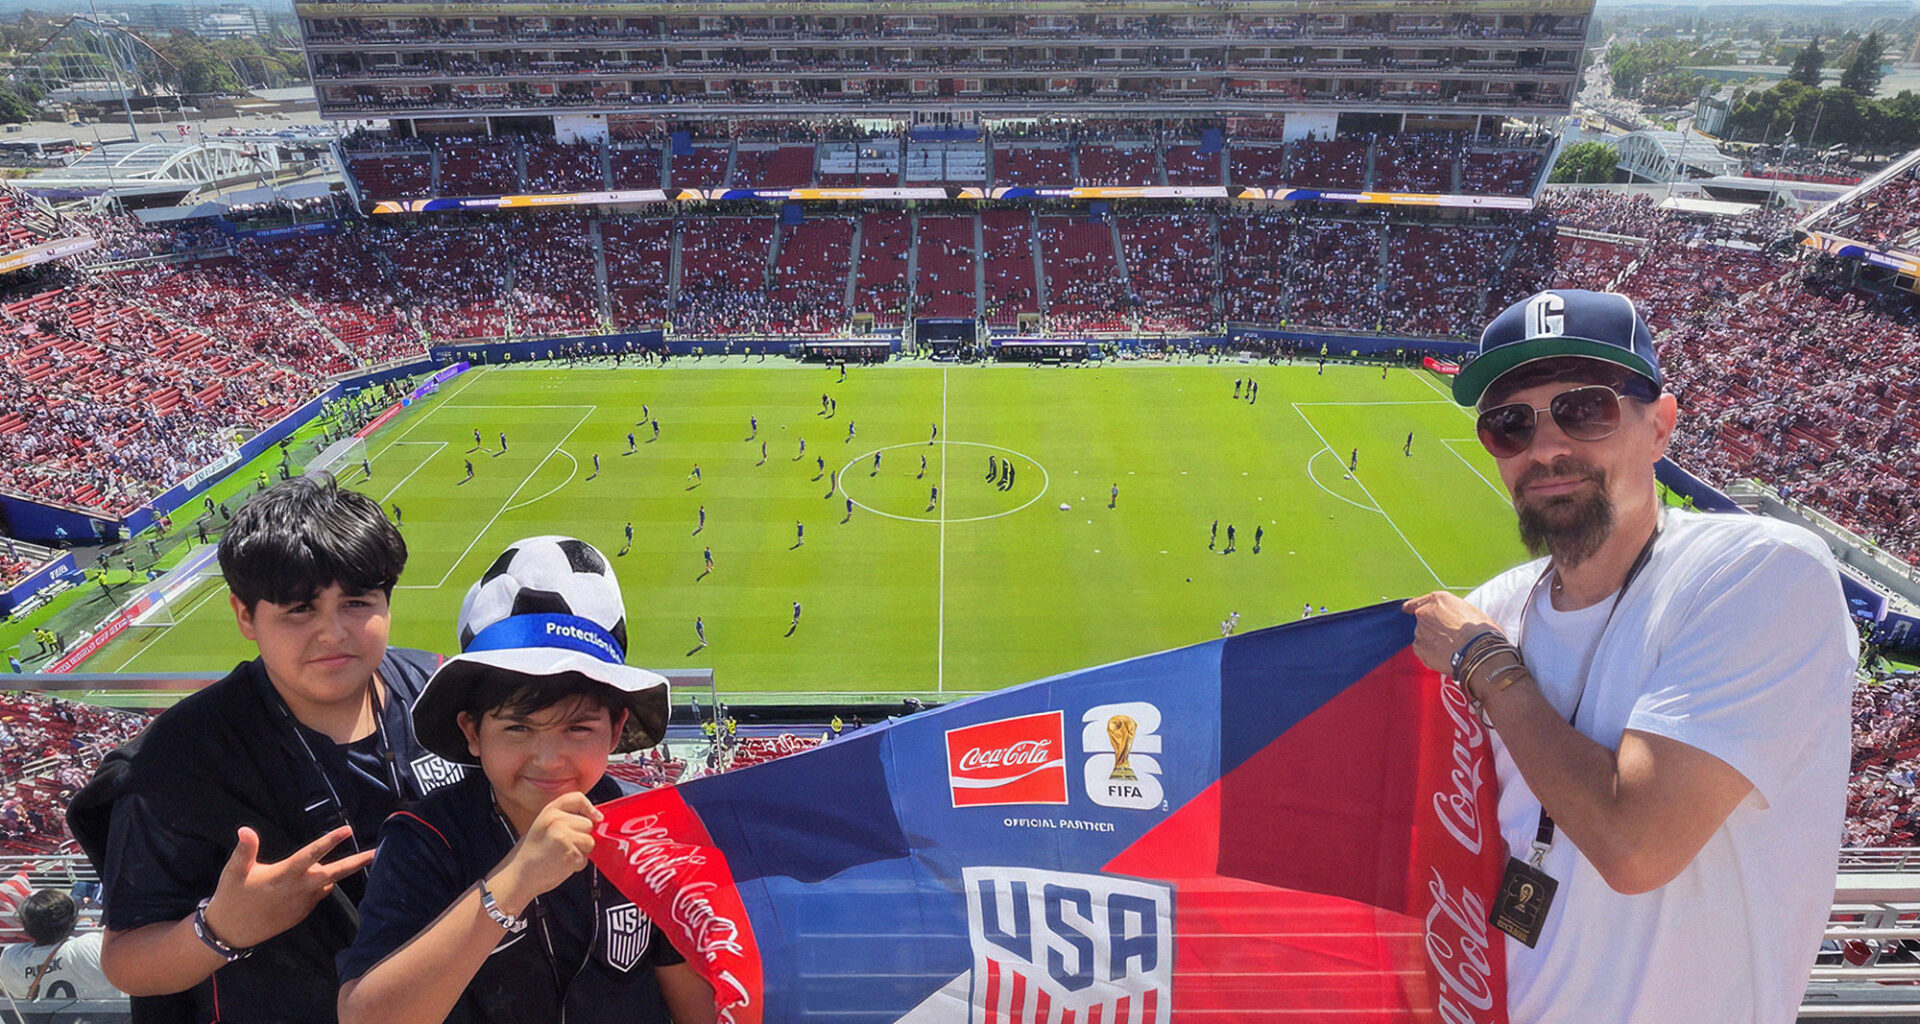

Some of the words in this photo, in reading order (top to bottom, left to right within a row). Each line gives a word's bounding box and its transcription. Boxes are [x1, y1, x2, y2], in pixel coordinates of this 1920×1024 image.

[1108, 785, 1143, 798] FIFA
[612, 908, 648, 933] USA
[977, 879, 1158, 992] USA
